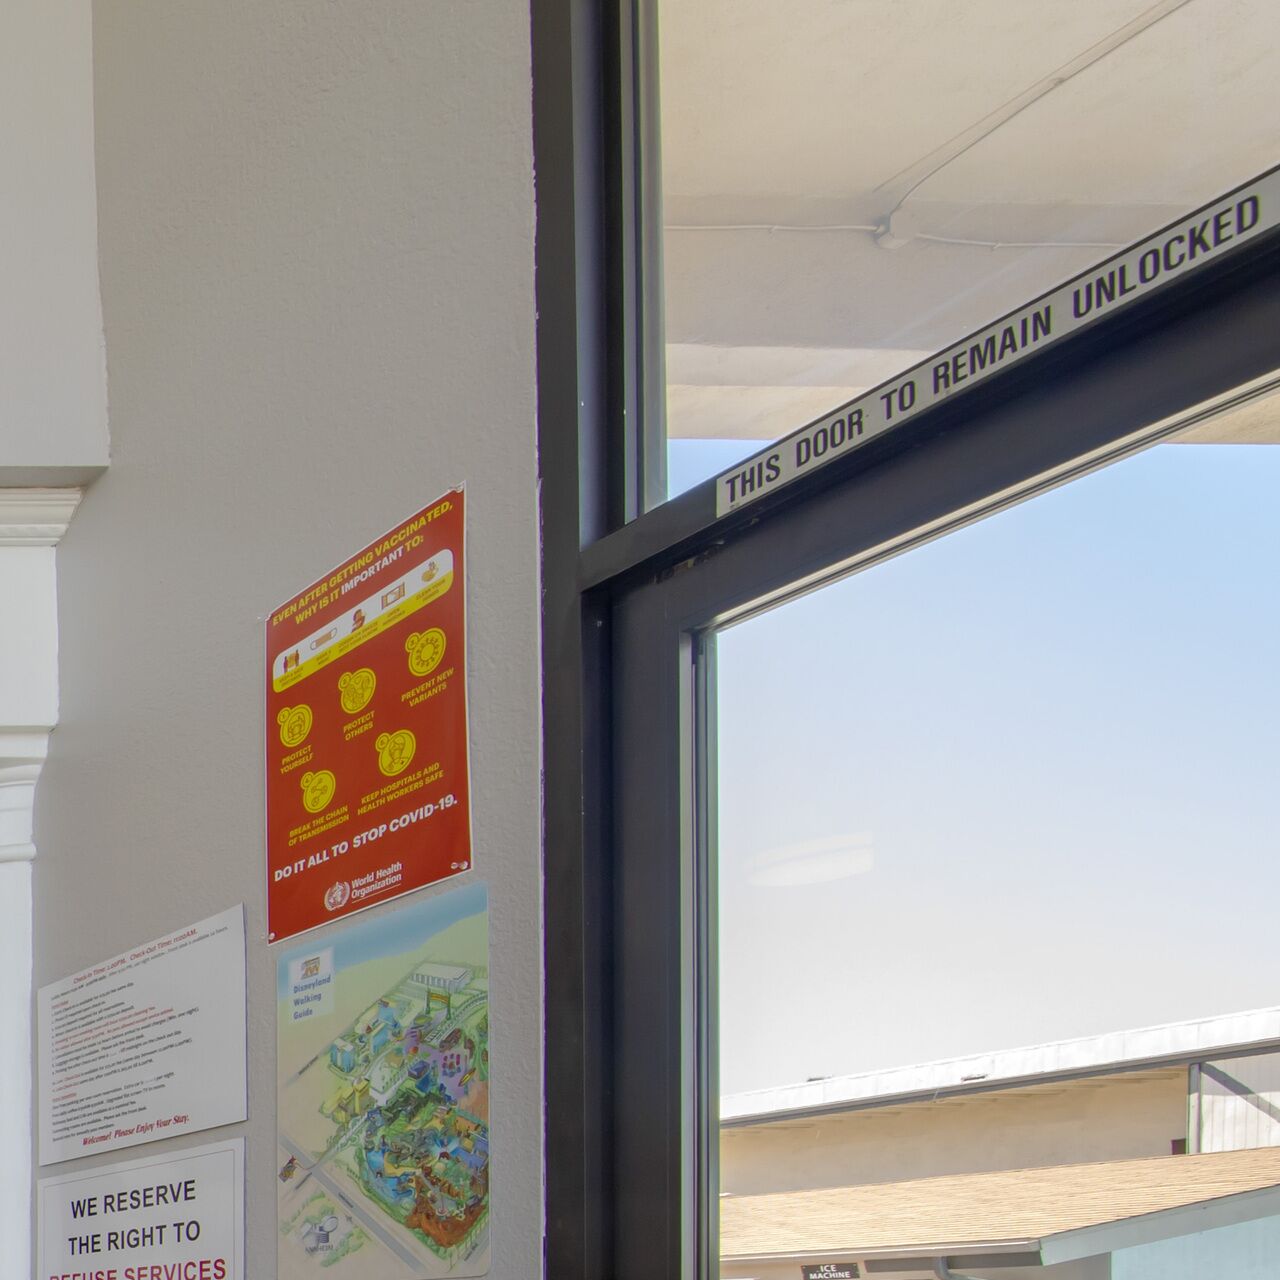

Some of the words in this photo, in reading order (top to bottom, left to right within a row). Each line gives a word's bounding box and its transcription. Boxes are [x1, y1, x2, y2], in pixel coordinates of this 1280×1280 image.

[725, 454, 781, 503] THIS
[796, 409, 863, 467] DOOR
[881, 380, 916, 419] TO
[933, 305, 1052, 394] REMAIN
[1073, 195, 1260, 318] UNLOCKED
[273, 605, 296, 626] EVEN
[299, 584, 327, 607] AFTER
[330, 553, 373, 586] GETTING
[375, 501, 453, 556] VACCINATED,
[296, 605, 317, 624] WHY
[319, 592, 329, 609] IS
[330, 590, 338, 601] IT
[342, 547, 403, 595] IMPORTANT
[405, 536, 424, 552] TO:
[402, 678, 435, 702] PREVENT
[435, 668, 454, 684] NEW
[409, 683, 447, 707] VARIANTS
[343, 711, 374, 733] PROTECT
[345, 722, 373, 741] OTHERS
[280, 753, 312, 774] YOURSELF
[282, 745, 312, 765] PROTECT
[358, 799, 385, 816] HEALTH
[386, 780, 423, 805] WORKERS
[425, 770, 443, 785] SAFE
[361, 792, 379, 804] KEEP
[381, 771, 422, 795] HOSPITALS
[423, 763, 439, 776] AND
[289, 825, 310, 837] BREAK
[312, 818, 324, 828] THE
[325, 806, 348, 821] CHAIN
[289, 838, 297, 847] OF
[299, 814, 349, 842] TRANSMISSION
[275, 865, 292, 882] DO
[294, 860, 305, 873] IT
[307, 851, 329, 868] ALL
[332, 842, 348, 857] TO
[353, 825, 386, 848] STOP
[390, 794, 457, 832] COVID-19.
[351, 873, 374, 888] World
[376, 862, 402, 879] Health
[351, 874, 401, 898] Organization
[294, 974, 331, 993] Disneyland
[293, 993, 321, 1006] Walking
[293, 1008, 312, 1019] Guide
[83, 1131, 112, 1145] Welcome!
[114, 1127, 134, 1139] Please
[136, 1122, 154, 1135] Enjoy
[156, 1117, 171, 1129] Your
[71, 1198, 97, 1218] WE
[104, 1180, 196, 1214] RESERVE
[68, 1234, 101, 1255] THE
[108, 1225, 166, 1251] RIGHT
[173, 1220, 200, 1242] TO
